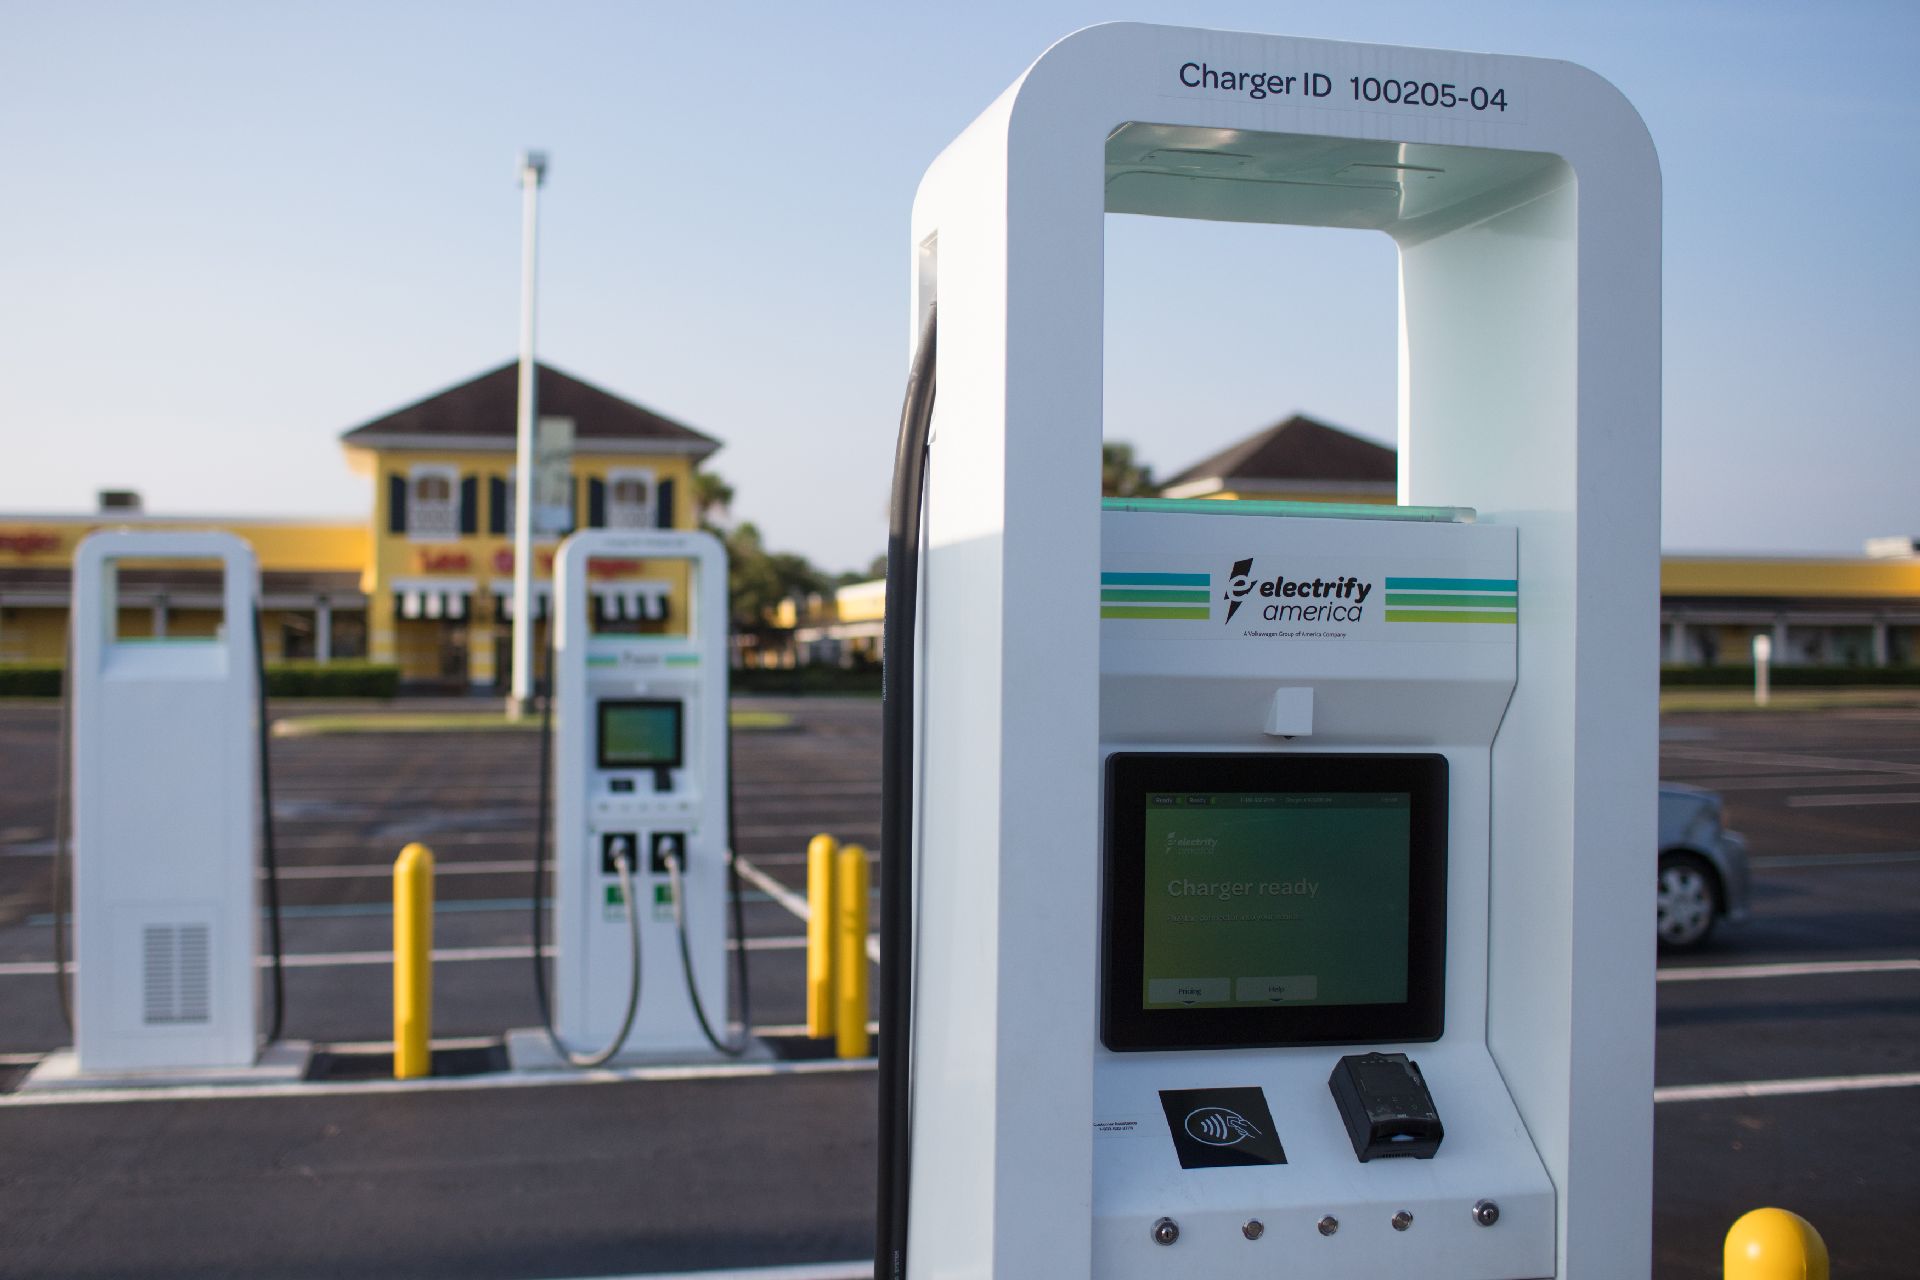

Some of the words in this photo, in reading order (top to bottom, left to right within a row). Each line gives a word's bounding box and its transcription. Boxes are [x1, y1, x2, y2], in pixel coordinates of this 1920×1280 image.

[1179, 62, 1296, 100] Charger
[1303, 72, 1332, 98] ID
[1350, 76, 1508, 112] 100205-04
[1259, 575, 1372, 604] electrify
[1263, 602, 1363, 622] america
[1167, 878, 1254, 901] Charger
[1259, 877, 1319, 899] ready
[1268, 985, 1285, 994] Help
